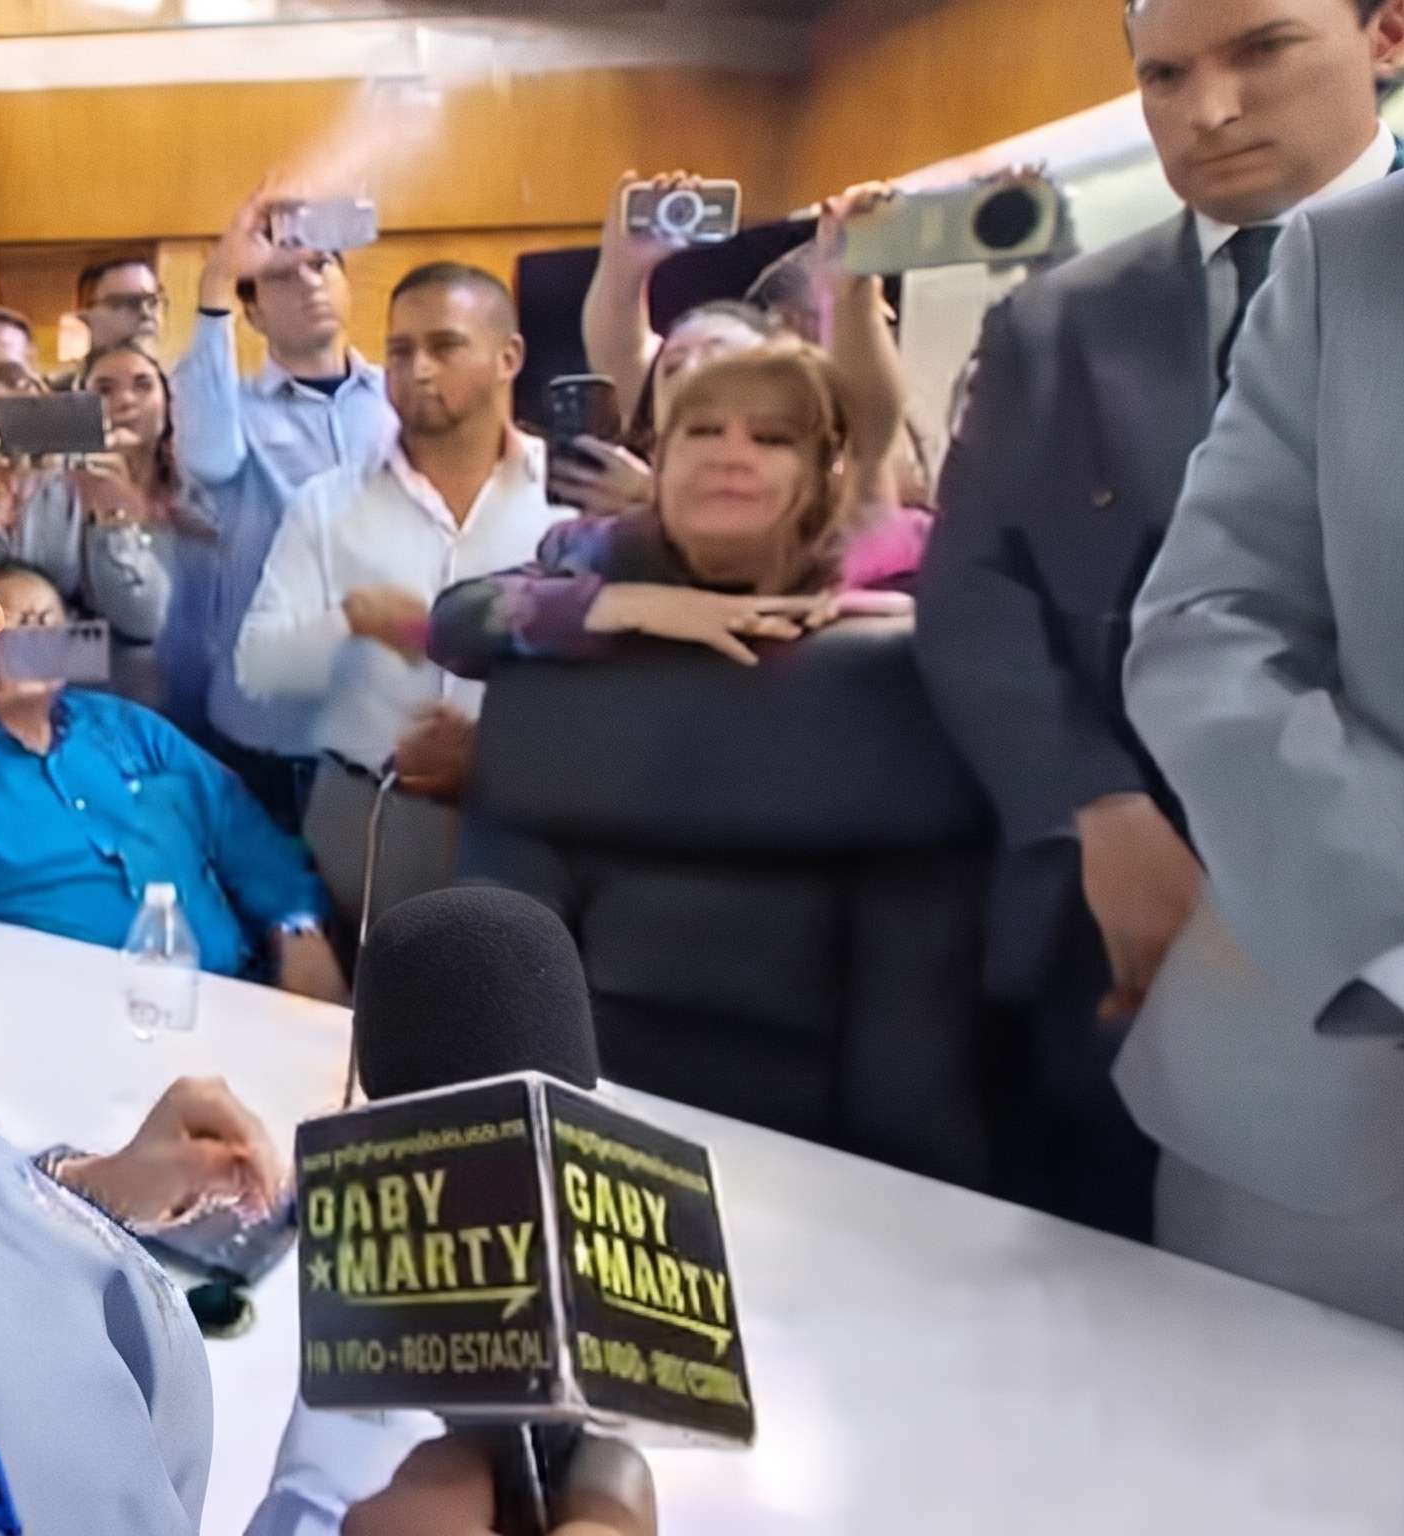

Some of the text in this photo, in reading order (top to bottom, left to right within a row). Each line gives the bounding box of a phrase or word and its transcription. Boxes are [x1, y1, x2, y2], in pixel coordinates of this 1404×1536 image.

[563, 1161, 667, 1246] GABY
[337, 1221, 534, 1296] MARTY
[593, 1231, 727, 1325] MARTY
